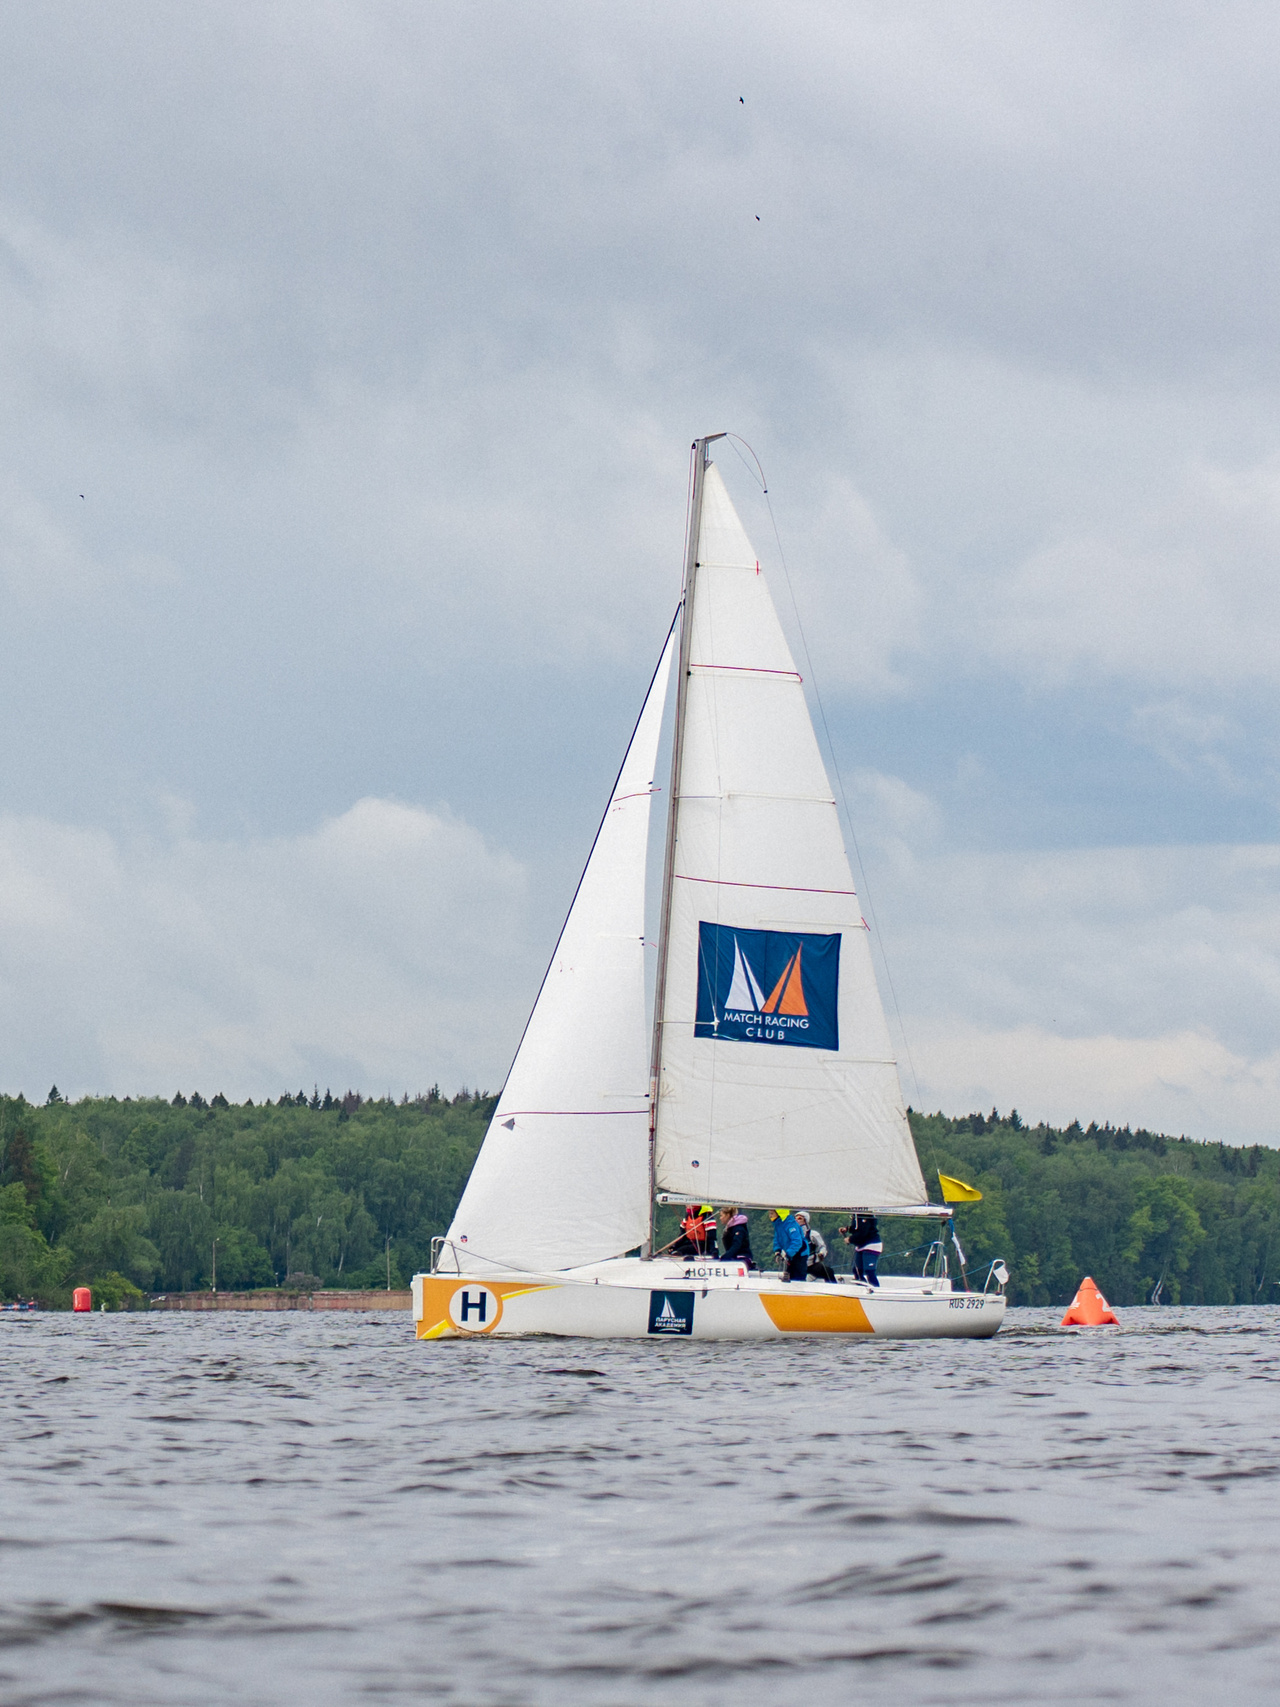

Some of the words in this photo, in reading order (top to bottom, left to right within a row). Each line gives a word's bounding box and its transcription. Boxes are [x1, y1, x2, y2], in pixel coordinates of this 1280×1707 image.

[723, 1012, 762, 1024] MATCH
[764, 1016, 809, 1029] RACING
[745, 1027, 785, 1040] CLUB
[689, 1268, 729, 1277] HOTEL
[461, 1291, 487, 1322] H
[949, 1298, 965, 1309] RUS
[966, 1298, 985, 1309] 2929
